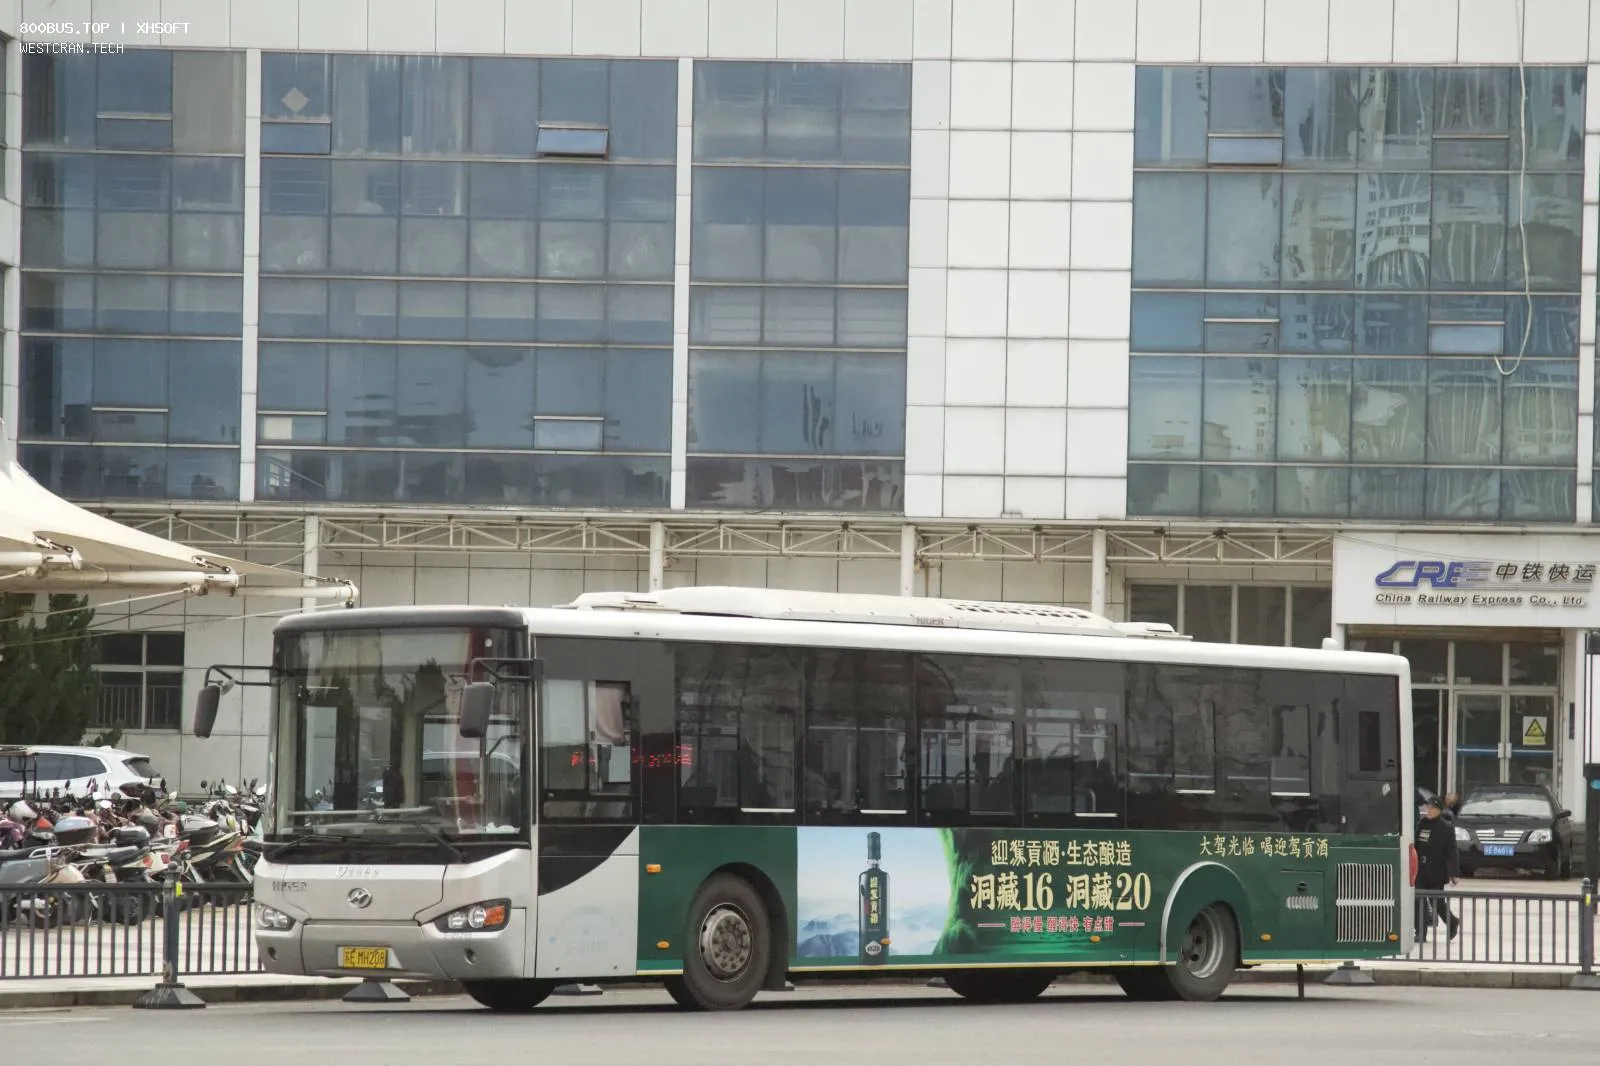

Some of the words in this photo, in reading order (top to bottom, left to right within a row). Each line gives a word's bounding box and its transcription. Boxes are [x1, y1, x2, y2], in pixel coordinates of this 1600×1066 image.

[1495, 562, 1597, 582] 中铁快运
[1375, 593, 1412, 604] China
[1418, 594, 1468, 605] Railway
[1472, 594, 1523, 605] Express
[1200, 835, 1255, 857] 大驾光临
[1260, 836, 1329, 859] 喝迎驾贡酒
[970, 872, 1054, 911] 洞藏16
[1065, 872, 1151, 911] 洞藏20
